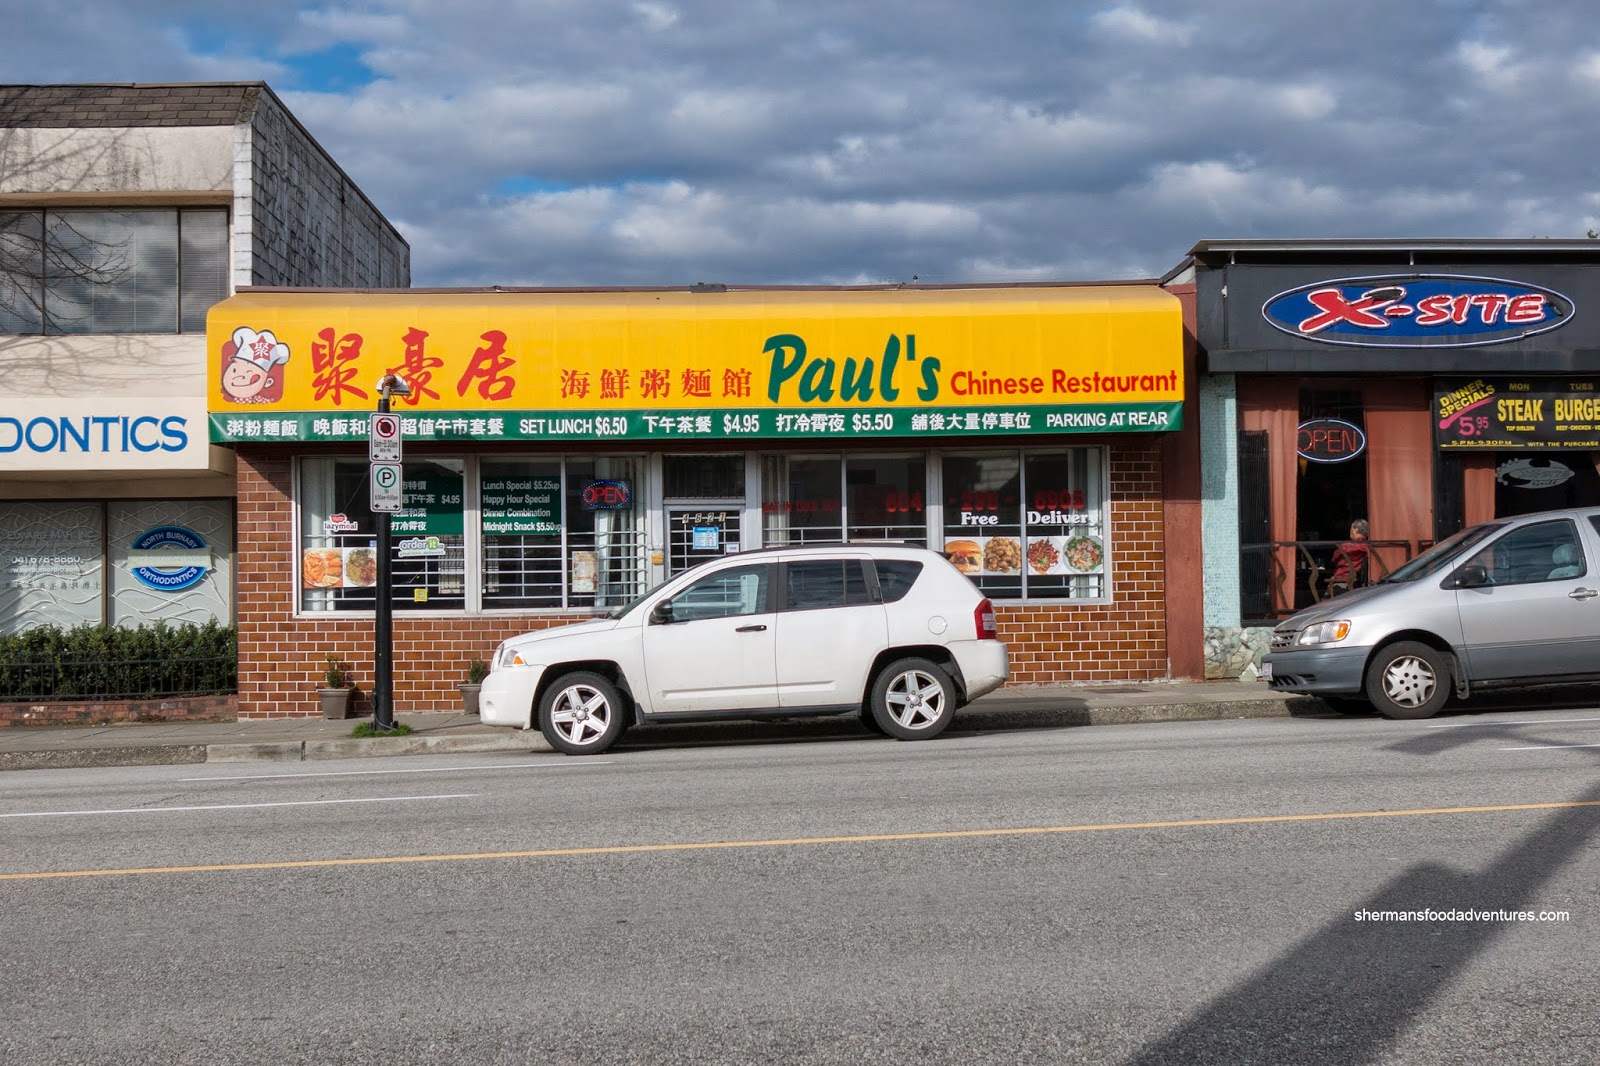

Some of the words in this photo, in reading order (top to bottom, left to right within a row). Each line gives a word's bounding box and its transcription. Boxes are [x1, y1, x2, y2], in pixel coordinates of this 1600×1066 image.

[1298, 286, 1547, 335] X-SITE
[762, 333, 941, 404] Paul's
[560, 368, 752, 399] 海鮮粥麵館
[950, 370, 1044, 396] Chinese
[1052, 368, 1177, 394] Restaurant
[1509, 383, 1530, 391] MON
[1569, 382, 1594, 391] TUES
[1439, 379, 1485, 407] DINNER
[1439, 384, 1495, 418] SPECIALS
[1497, 399, 1543, 422] STEAK
[1554, 398, 1600, 421] BURGE
[227, 419, 298, 436] 粥粉麵飯
[313, 419, 371, 436] 晚飯和
[401, 418, 504, 436] 超值午市套餐
[520, 419, 546, 434] SET
[548, 419, 592, 434] LUNCH
[594, 416, 628, 436] $6.50
[642, 415, 712, 433] 下午茶餐
[723, 414, 759, 433] $4.95
[852, 413, 893, 432] $5.50
[1046, 412, 1106, 427] PARKING
[1109, 412, 1124, 426] AT
[1128, 411, 1168, 426] REAR
[1458, 416, 1489, 436] 5.95
[1298, 429, 1356, 452] OPEN
[382, 472, 392, 483] P
[482, 480, 504, 490] Lunch
[506, 480, 531, 491] Special
[533, 480, 560, 491] $5.25up
[441, 494, 461, 504] $4.95
[482, 494, 505, 505] Happy
[507, 494, 523, 504] Hour
[525, 494, 550, 505] Special
[584, 486, 626, 503] OPEN
[482, 508, 506, 517] Dinner
[507, 508, 551, 517] Combination
[960, 512, 999, 525] Free
[324, 522, 357, 530] lazymeal
[482, 522, 513, 533] Midnight
[514, 522, 535, 531] Snack
[141, 532, 164, 548] NORTH
[166, 532, 198, 548] BURNABY
[139, 567, 198, 584] ORTHODONTICS
